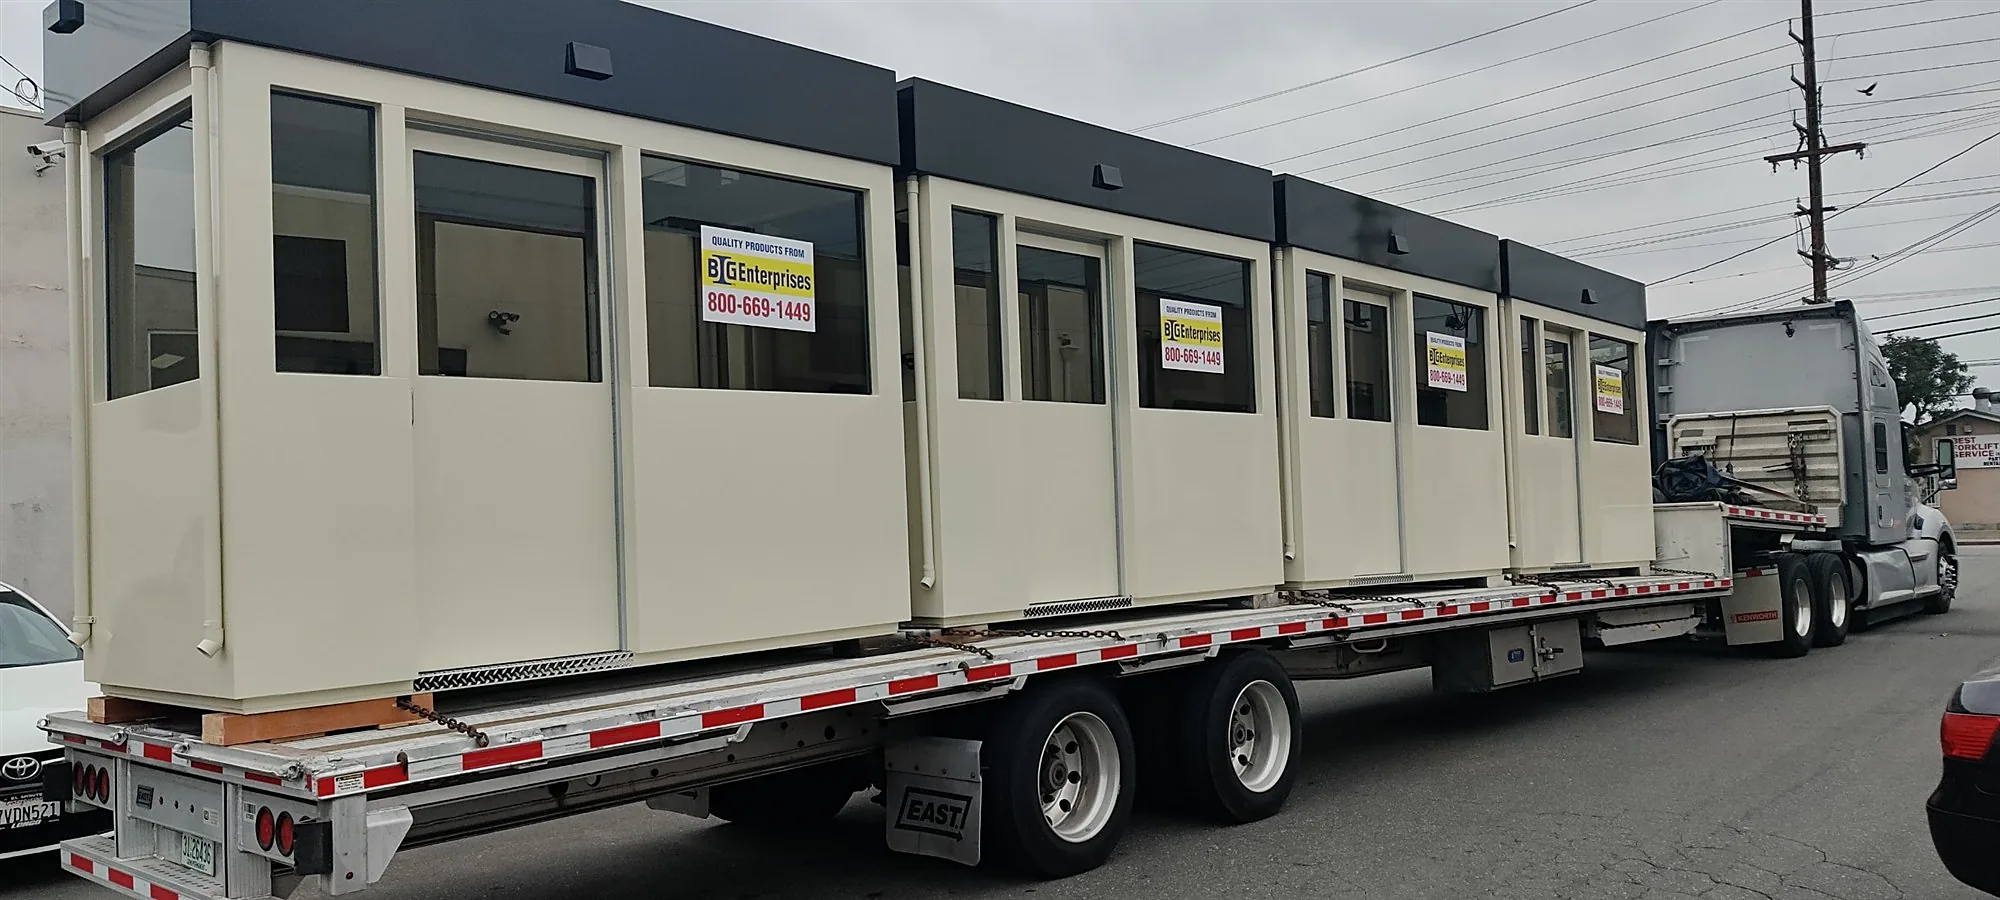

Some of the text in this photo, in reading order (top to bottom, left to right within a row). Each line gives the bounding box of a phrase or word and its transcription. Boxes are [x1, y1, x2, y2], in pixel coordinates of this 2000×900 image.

[711, 235, 805, 259] QUALITY PRODUCTS FROM
[707, 291, 811, 321] 800-669-1449
[1166, 305, 1217, 319] QUALITY PRODUCTS FROM
[1165, 346, 1221, 366] 800-669-1449
[1430, 369, 1465, 386] 800-669-1449
[1952, 436, 1976, 444] BEST
